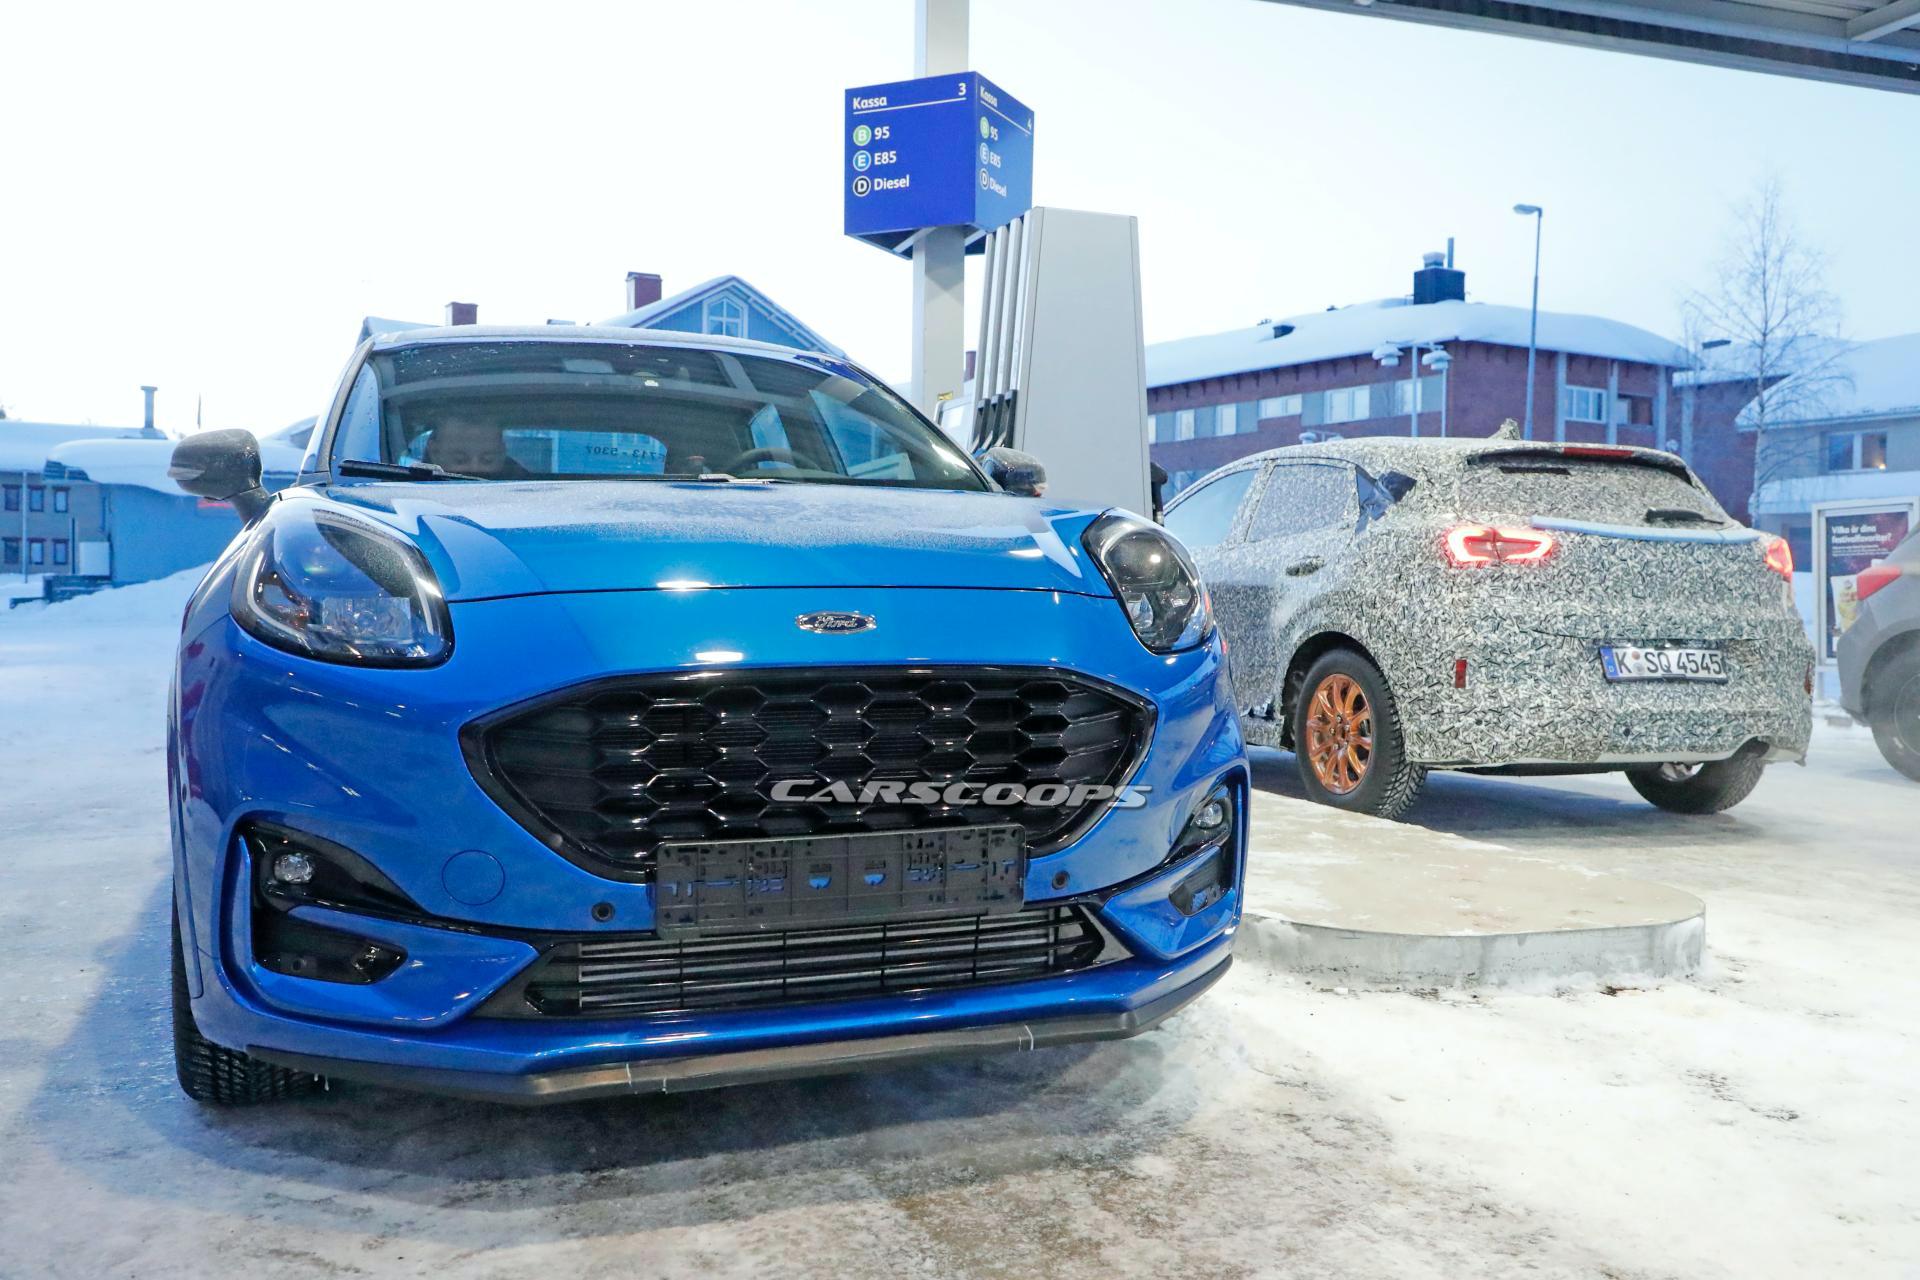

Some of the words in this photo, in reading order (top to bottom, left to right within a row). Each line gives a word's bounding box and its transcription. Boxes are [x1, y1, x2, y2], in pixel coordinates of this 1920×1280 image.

[853, 96, 888, 110] Kassa
[958, 83, 967, 96] 3
[980, 86, 998, 107] Kassa
[874, 126, 890, 140] 95
[990, 126, 999, 141] 95
[873, 151, 897, 166] E85
[989, 151, 1002, 168] E85
[873, 174, 910, 191] Diesel
[989, 177, 1008, 197] Diesel
[814, 615, 858, 629] Ford
[1614, 651, 1633, 674] K
[1644, 651, 1673, 674] SQ
[1676, 652, 1722, 675] 4545
